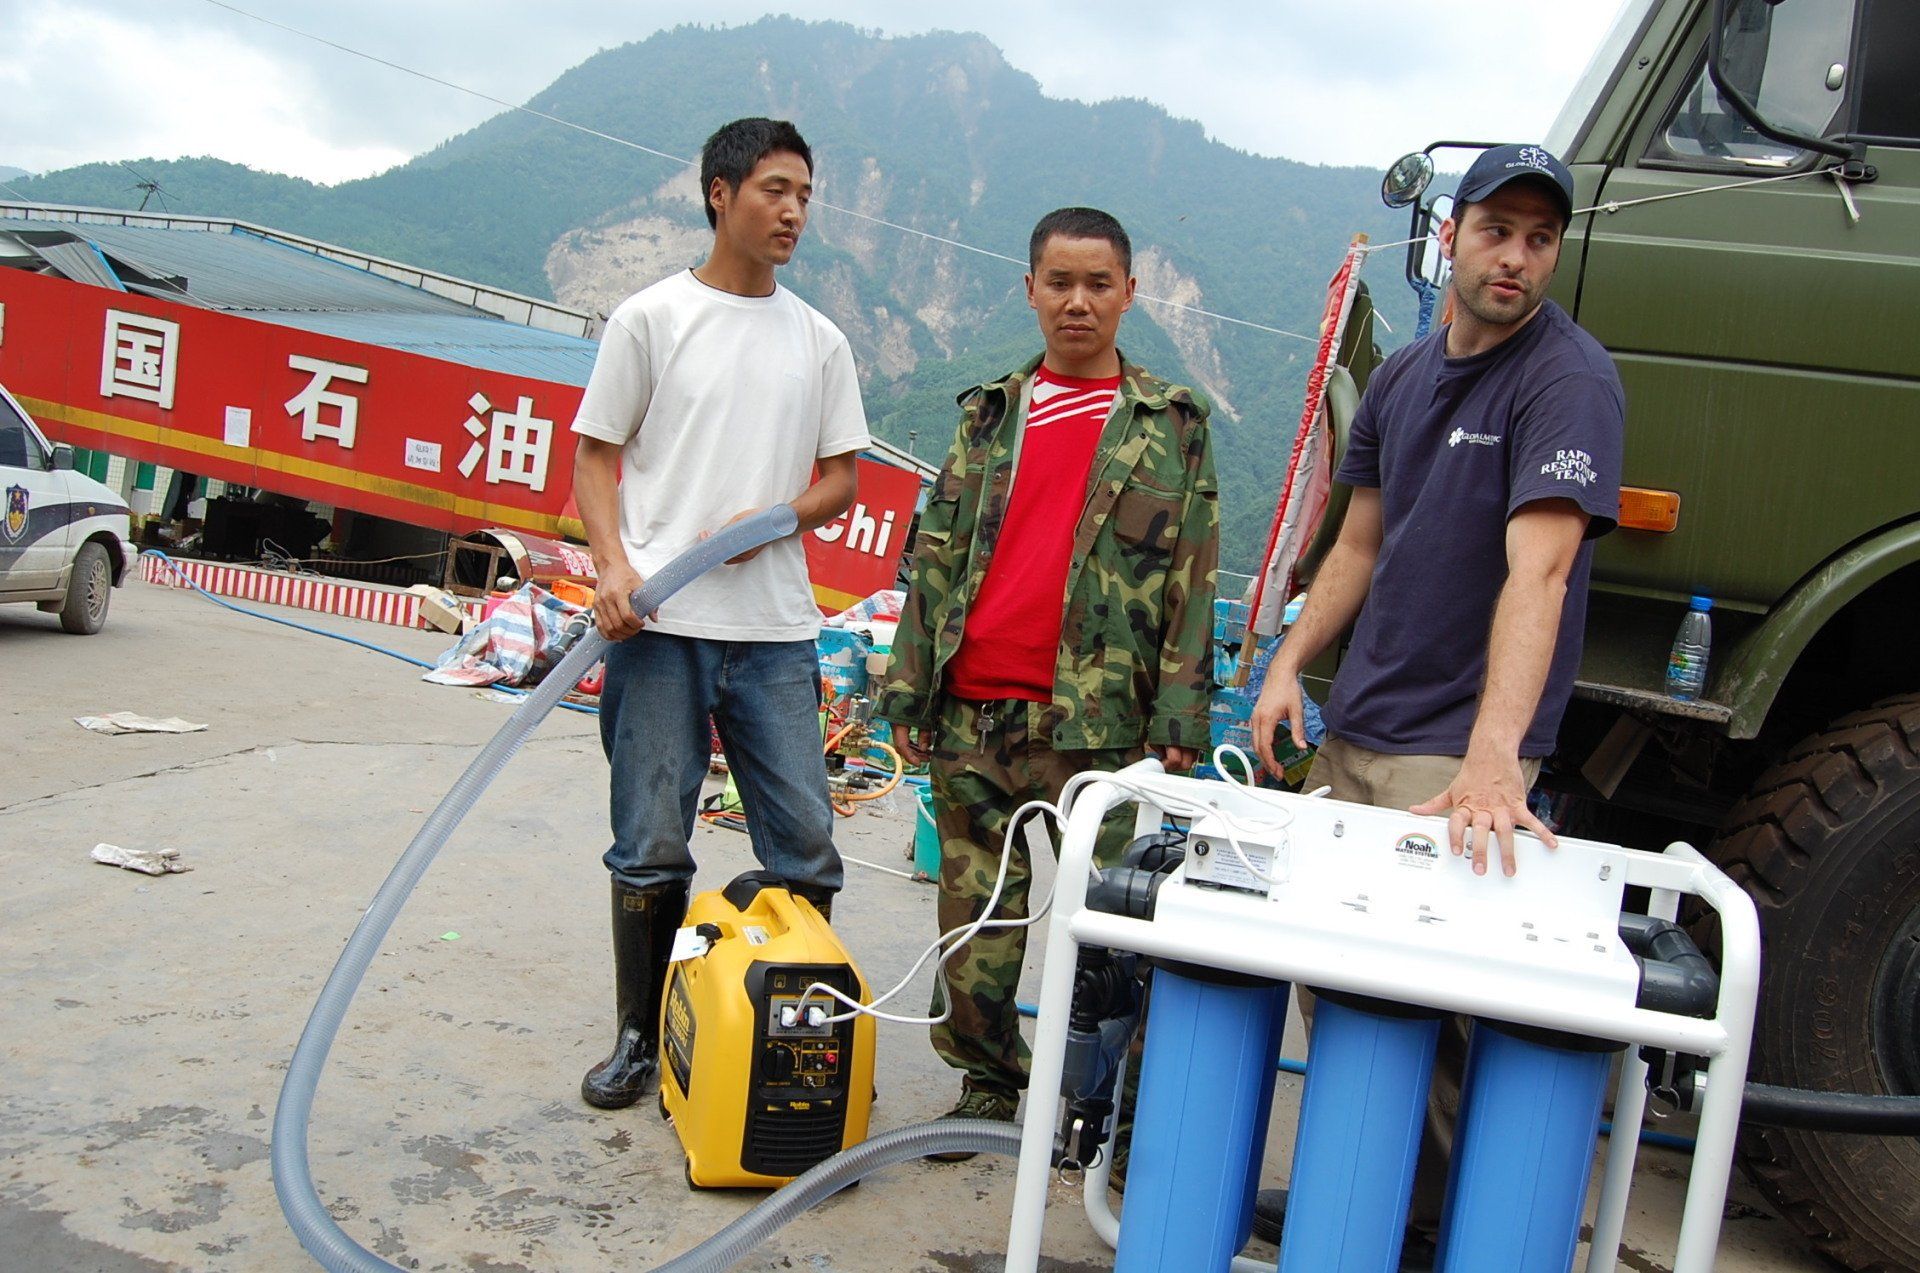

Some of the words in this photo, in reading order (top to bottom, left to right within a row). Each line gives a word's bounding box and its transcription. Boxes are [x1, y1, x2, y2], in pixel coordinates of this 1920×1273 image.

[0, 302, 553, 492] 国石油
[1556, 449, 1592, 466] RAPID
[1540, 458, 1598, 483] RESPONSE
[1554, 469, 1587, 487] TEAM
[1405, 840, 1432, 852] Noah
